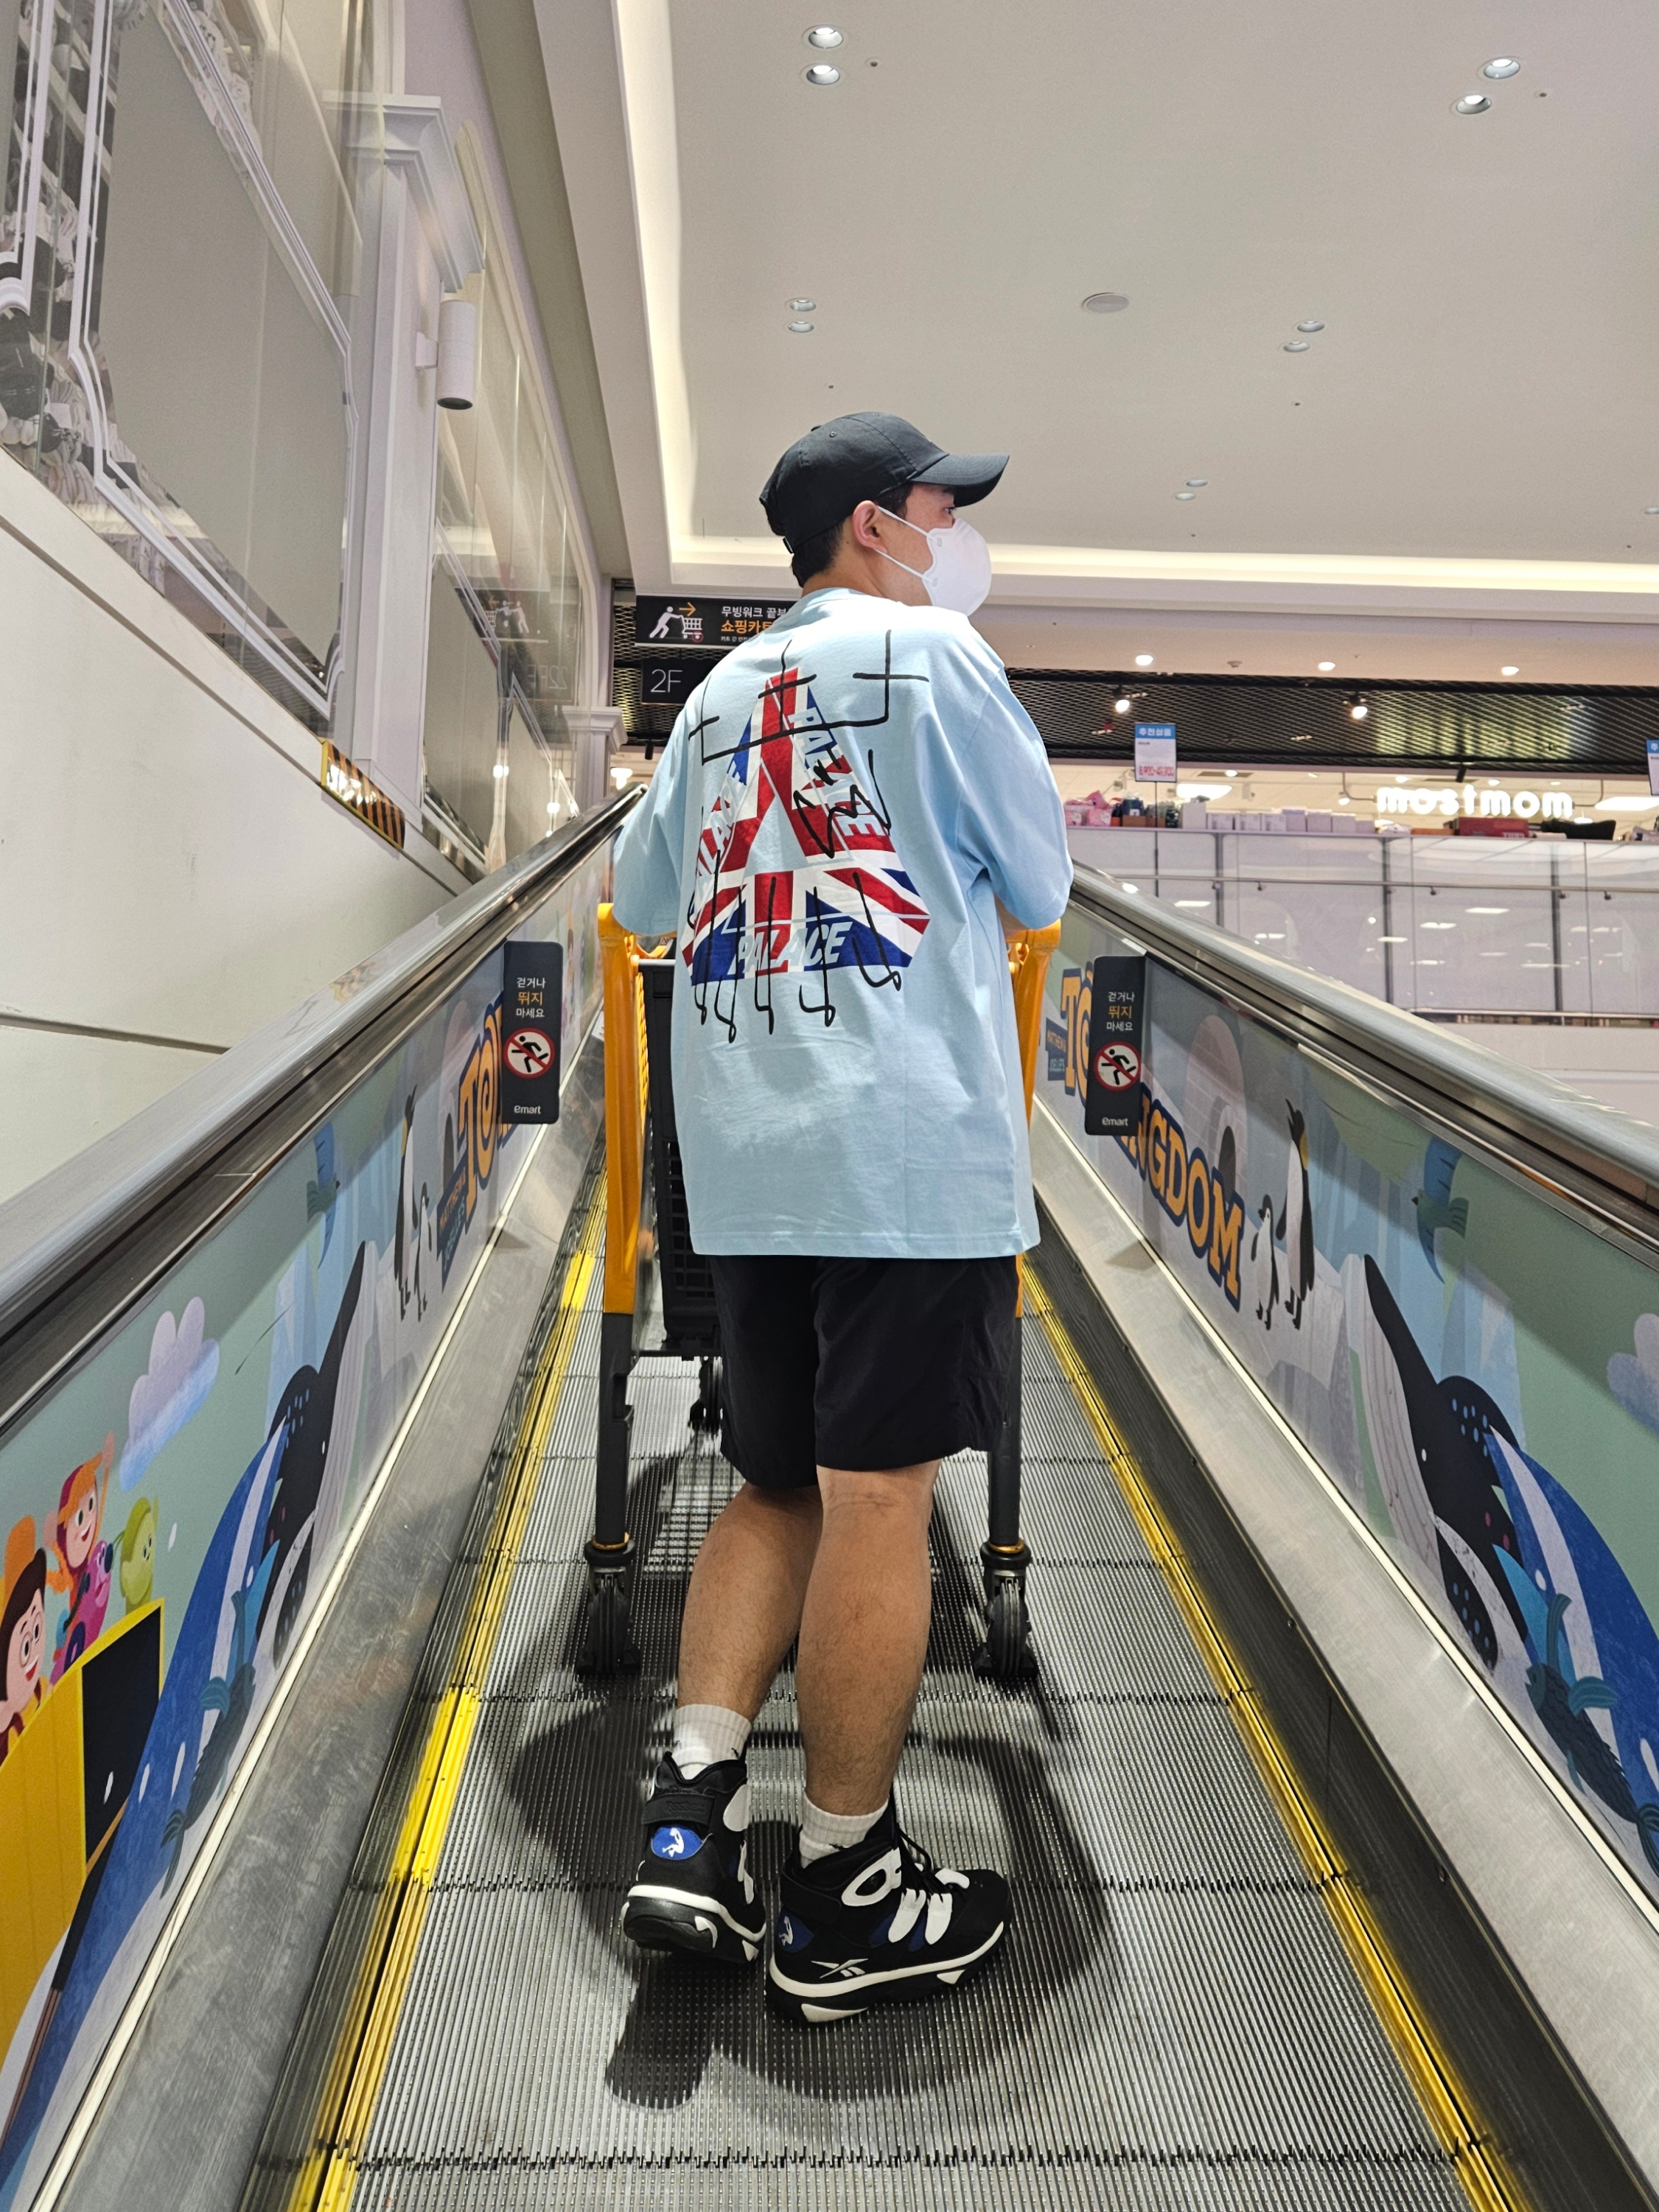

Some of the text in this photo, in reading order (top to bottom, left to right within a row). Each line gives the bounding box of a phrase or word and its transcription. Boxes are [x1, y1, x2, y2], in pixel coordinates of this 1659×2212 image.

[722, 606, 790, 619] 무빙워크 끝부
[650, 668, 683, 693] 2F
[787, 707, 885, 838] PALACE
[1377, 784, 1573, 818] mostmom
[727, 920, 853, 976] PALACE
[517, 977, 546, 989] 걷거나
[517, 991, 543, 1006] 뛰지
[1108, 991, 1136, 1003] 걷거나
[516, 1007, 545, 1018] 마세요
[1108, 1005, 1133, 1019] 뛰지
[1106, 1021, 1134, 1032] 마세요
[514, 1105, 542, 1115] emart
[1102, 1117, 1129, 1127] emart
